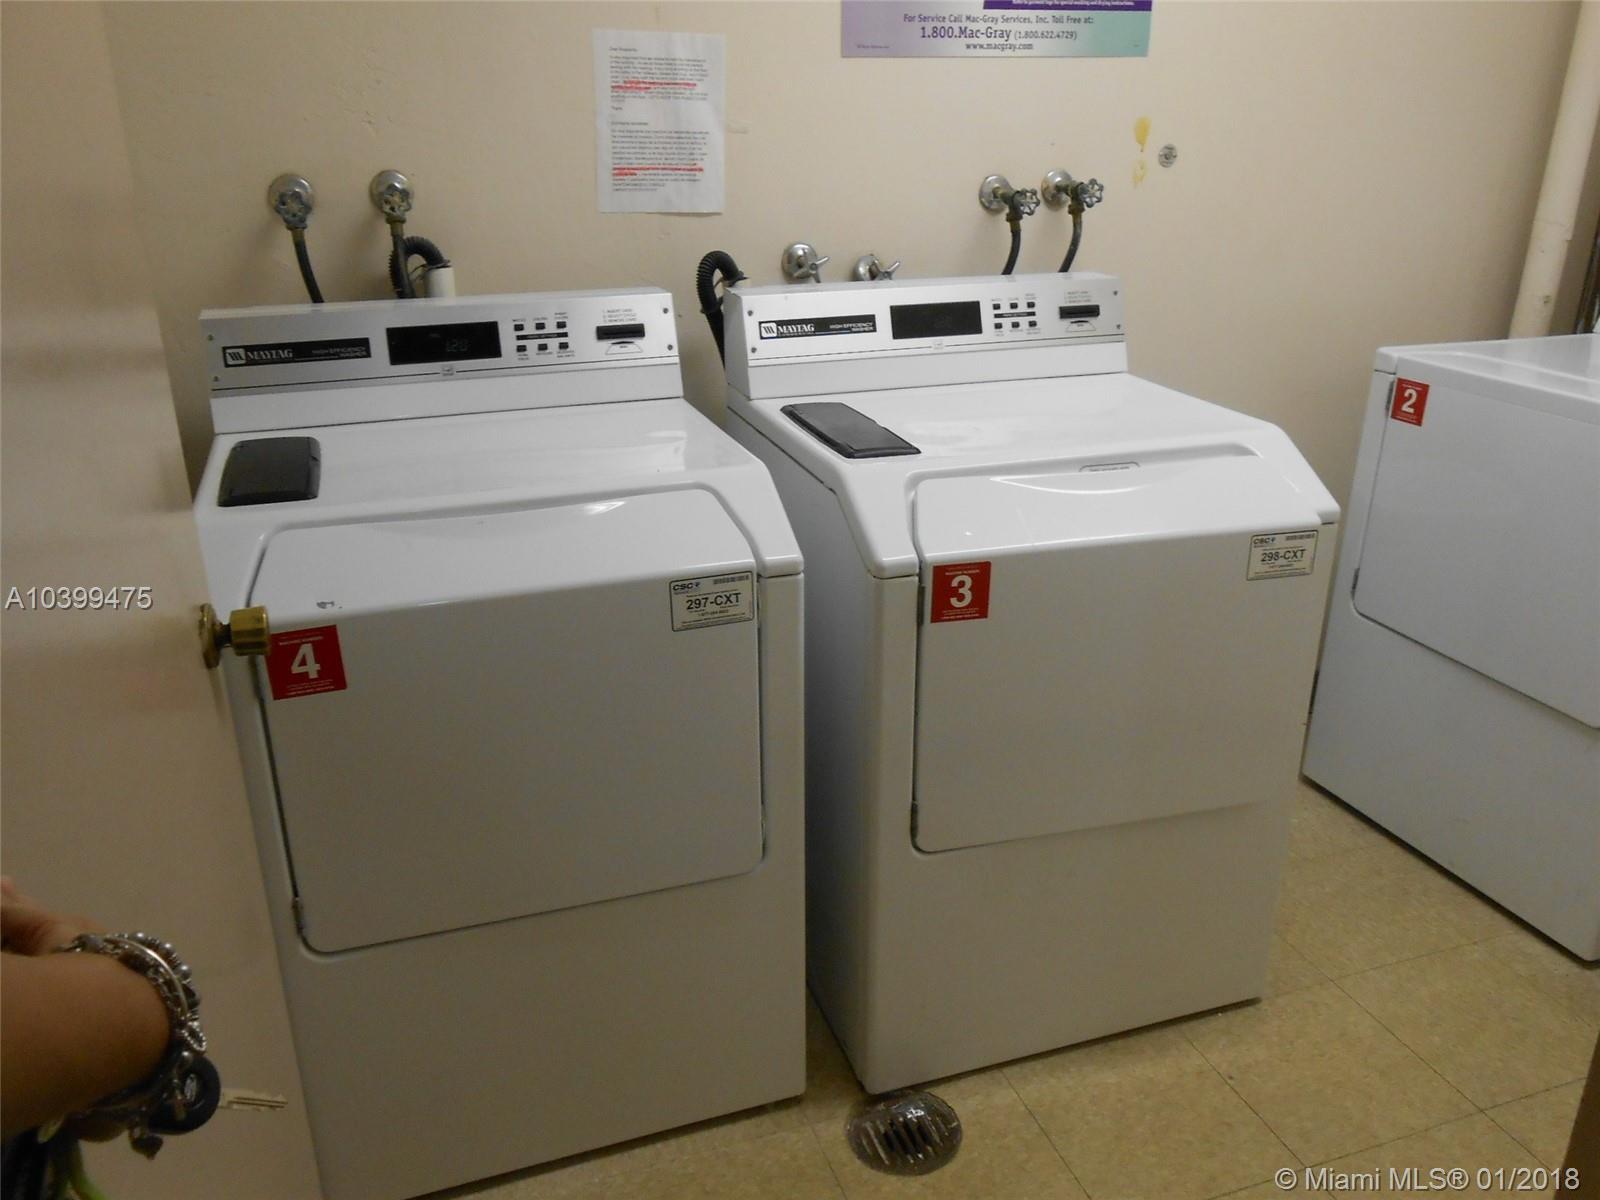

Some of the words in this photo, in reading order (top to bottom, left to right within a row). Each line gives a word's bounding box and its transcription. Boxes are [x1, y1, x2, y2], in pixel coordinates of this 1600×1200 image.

[903, 13, 917, 23] For
[918, 13, 946, 23] Service
[948, 14, 963, 23] Call
[965, 14, 999, 25] Mac-Gray
[1001, 15, 1033, 25] Services,
[1035, 15, 1050, 24] Inc.
[1051, 16, 1065, 24] Toll
[1066, 16, 1082, 24] Free
[1083, 16, 1094, 24] at:
[920, 26, 1012, 42] 1.800.Mac-Gray
[965, 42, 1034, 52] www.macgray.com
[777, 323, 815, 334] MAYTAG
[246, 349, 293, 360] MAYTAG
[1401, 388, 1418, 414] 2
[1261, 548, 1307, 562] 298-CXT
[672, 582, 694, 591] CSC
[950, 574, 973, 608] 3
[686, 592, 742, 610] 297-CXT
[290, 642, 321, 680] 4
